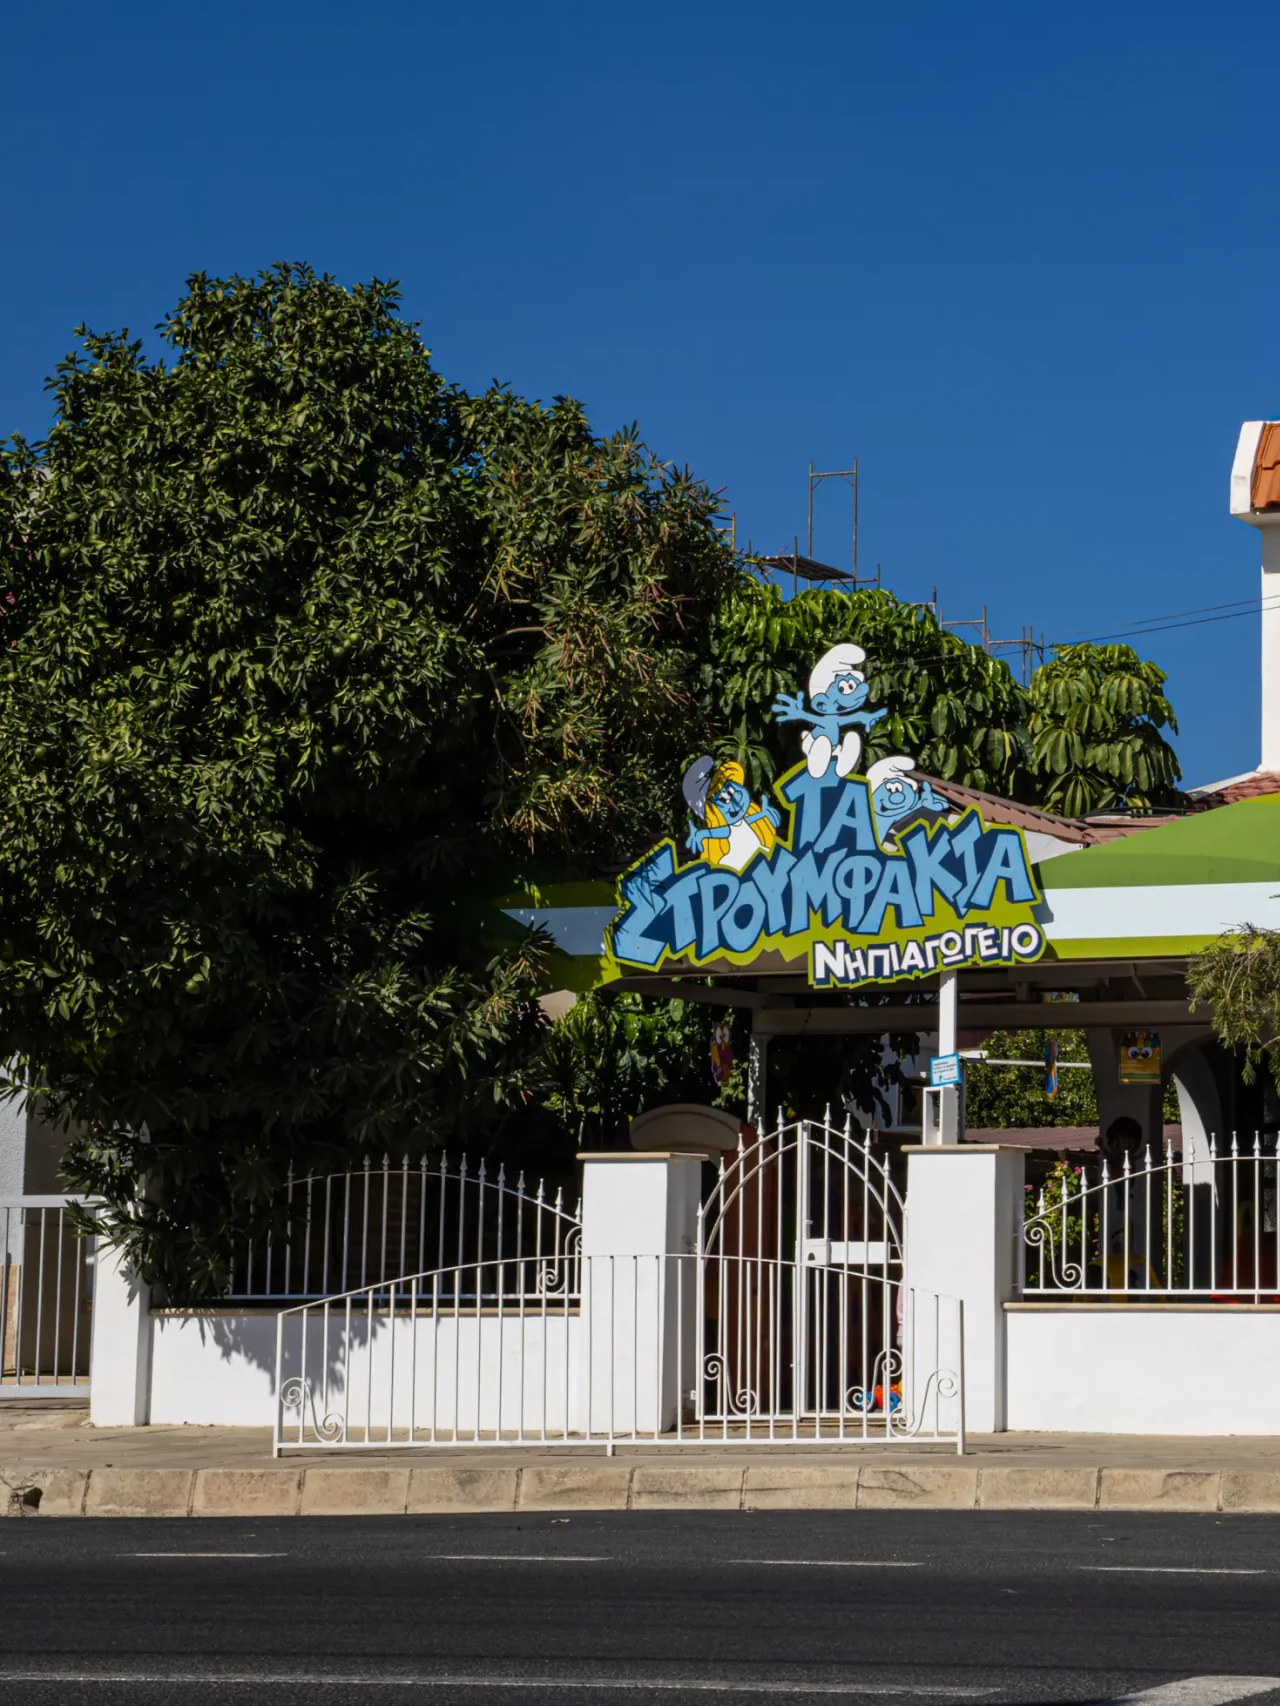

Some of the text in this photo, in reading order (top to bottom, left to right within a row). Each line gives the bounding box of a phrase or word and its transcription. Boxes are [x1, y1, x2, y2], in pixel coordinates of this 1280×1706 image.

[785, 768, 877, 854] ΤΑ
[612, 813, 1036, 965] ΣΤΡΟΥΜΦΑΚΙΑ
[814, 924, 1039, 980] ΝΗΠΙΑΓΩΓΕΙΟ
